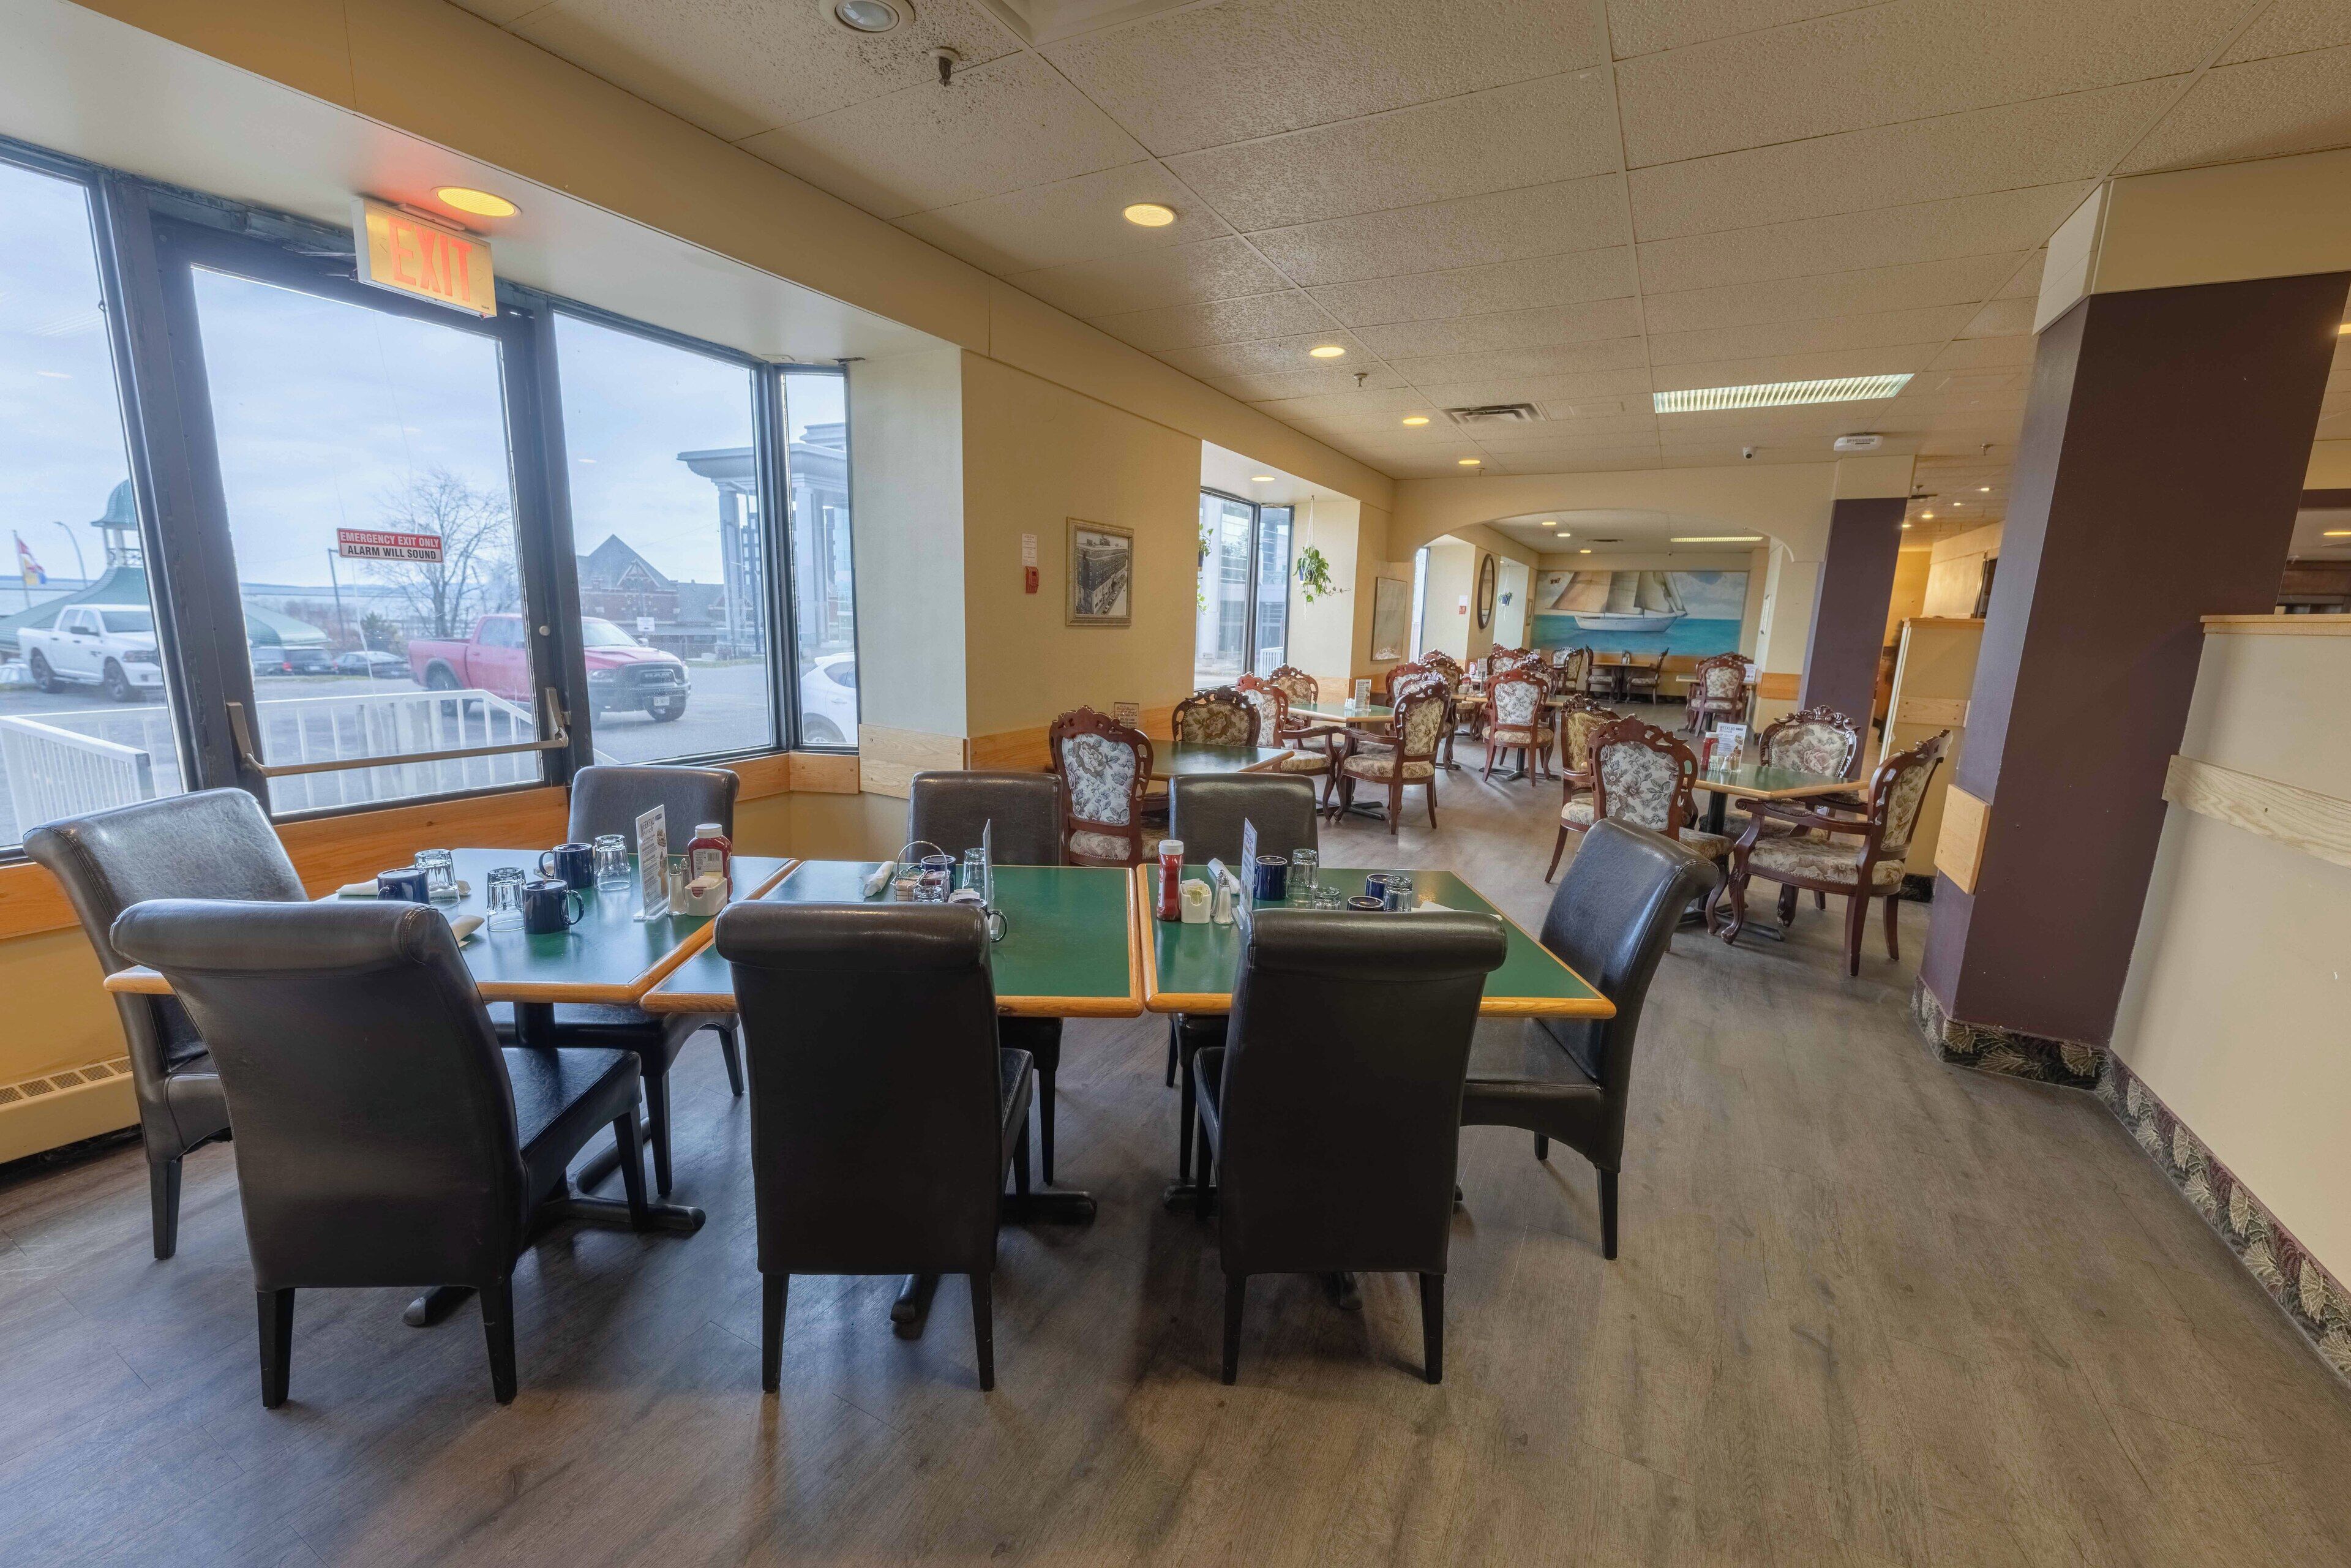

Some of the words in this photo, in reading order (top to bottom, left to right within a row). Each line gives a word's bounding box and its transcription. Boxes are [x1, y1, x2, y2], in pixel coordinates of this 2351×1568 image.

[387, 216, 472, 302] EXIT
[340, 531, 395, 545] EMERGENCY
[398, 536, 416, 546] EXIT
[419, 538, 439, 548] ONLY
[348, 545, 380, 556] ALARM
[382, 547, 405, 558] WILL
[407, 549, 436, 560] SOUND
